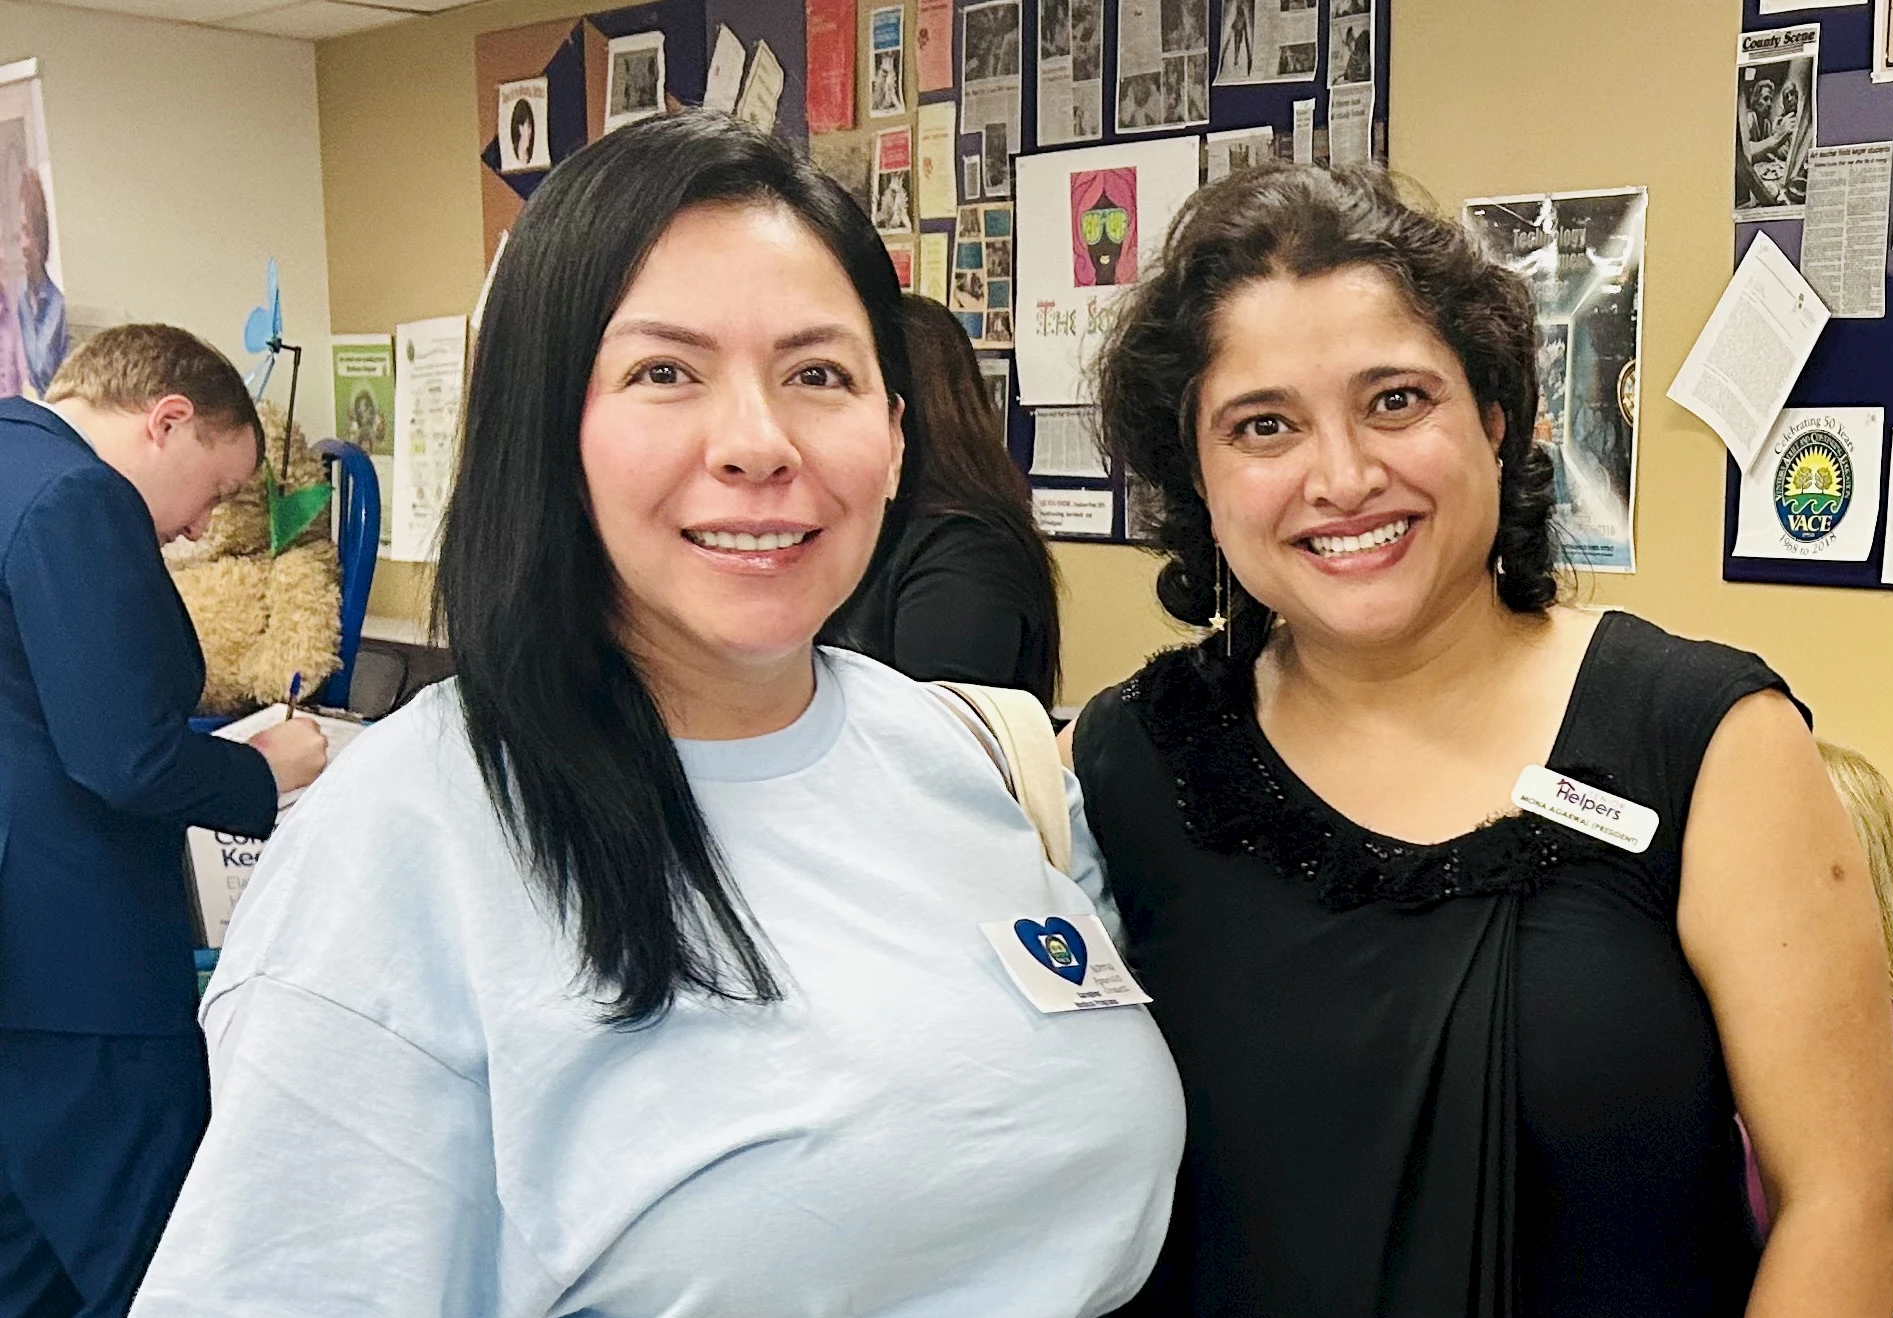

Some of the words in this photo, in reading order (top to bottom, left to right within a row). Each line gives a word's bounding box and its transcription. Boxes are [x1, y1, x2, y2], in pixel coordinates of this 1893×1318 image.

[1742, 34, 1782, 51] County
[1784, 30, 1816, 46] Scene
[1774, 415, 1822, 455] Celebrating
[1823, 415, 1836, 430] 50
[1836, 422, 1855, 453] Years
[1787, 514, 1833, 532] VACE
[1778, 533, 1798, 555] 1968
[1800, 545, 1810, 556] to
[1812, 532, 1838, 555] 2018
[1556, 784, 1622, 821] Helpers
